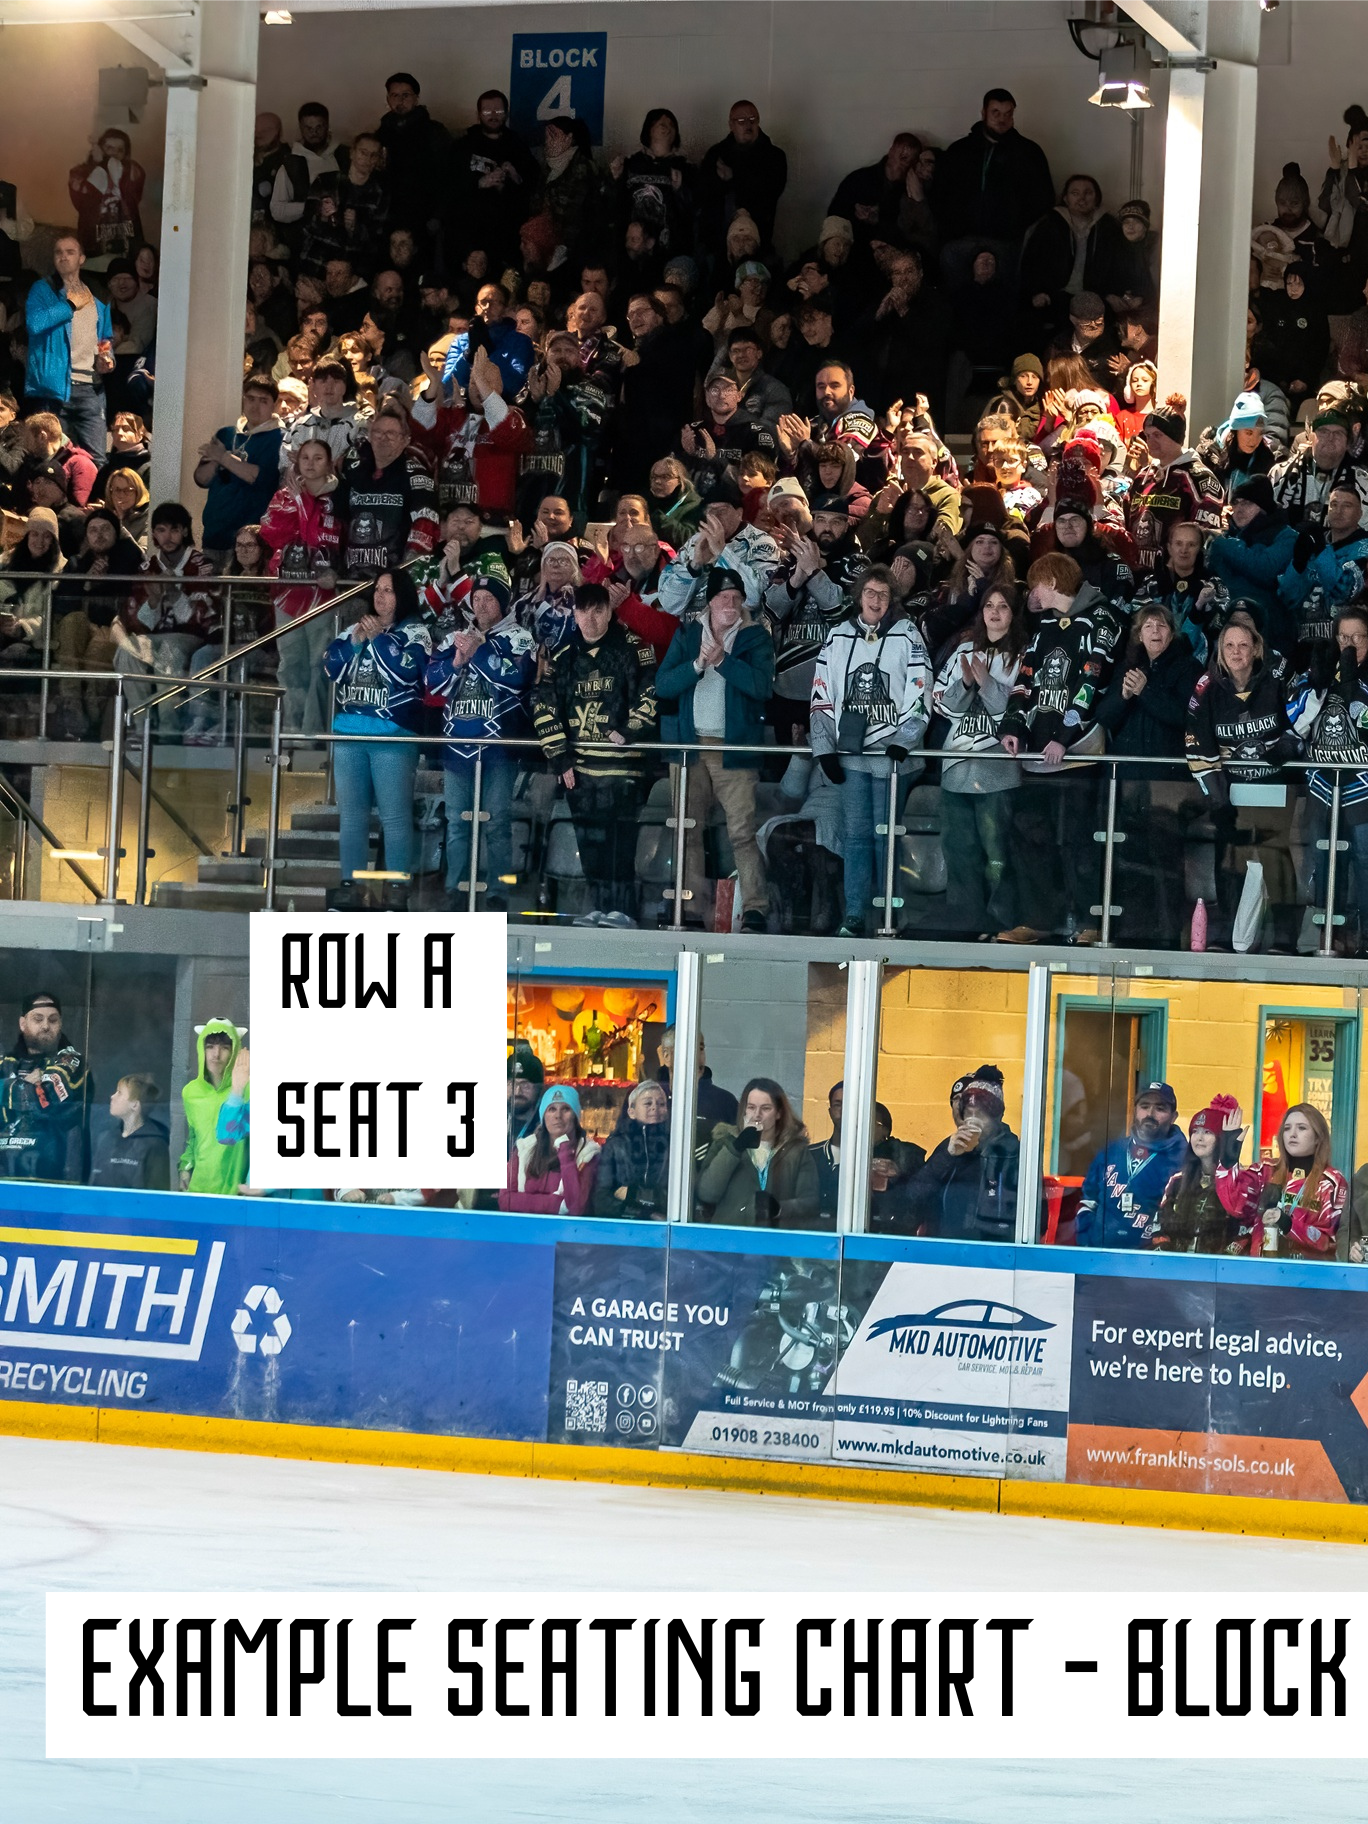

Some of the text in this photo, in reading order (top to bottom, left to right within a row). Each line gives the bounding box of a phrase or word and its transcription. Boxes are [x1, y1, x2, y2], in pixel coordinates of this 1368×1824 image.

[519, 48, 599, 70] BLOCK
[536, 75, 575, 122] 4
[1217, 725, 1234, 738] ALL
[1235, 724, 1246, 736] IN
[1247, 716, 1278, 734] BLACK
[570, 1298, 730, 1327] A GARAGE YOU
[569, 1326, 684, 1352] CAN TRUST
[889, 1328, 1047, 1363] MKD AUTOMOTIVE
[1091, 1320, 1344, 1361] For expert legal advice,
[1090, 1357, 1292, 1393] we're here to help.
[725, 1395, 741, 1406] Full
[743, 1397, 775, 1409] Service
[788, 1401, 810, 1411] MOT
[812, 1402, 835, 1412] from
[837, 1404, 856, 1415] only
[858, 1404, 895, 1416] £119.95
[902, 1408, 922, 1418] 10%
[924, 1409, 963, 1422] Discount
[966, 1412, 980, 1423] for
[982, 1414, 1024, 1428] Lightning
[1027, 1416, 1049, 1428] Fans
[712, 1426, 820, 1449] 01908 238400
[838, 1438, 1047, 1466] www.mkdautomotive.co.uk
[1086, 1446, 1296, 1477] www.franklins-sols.co.uk
